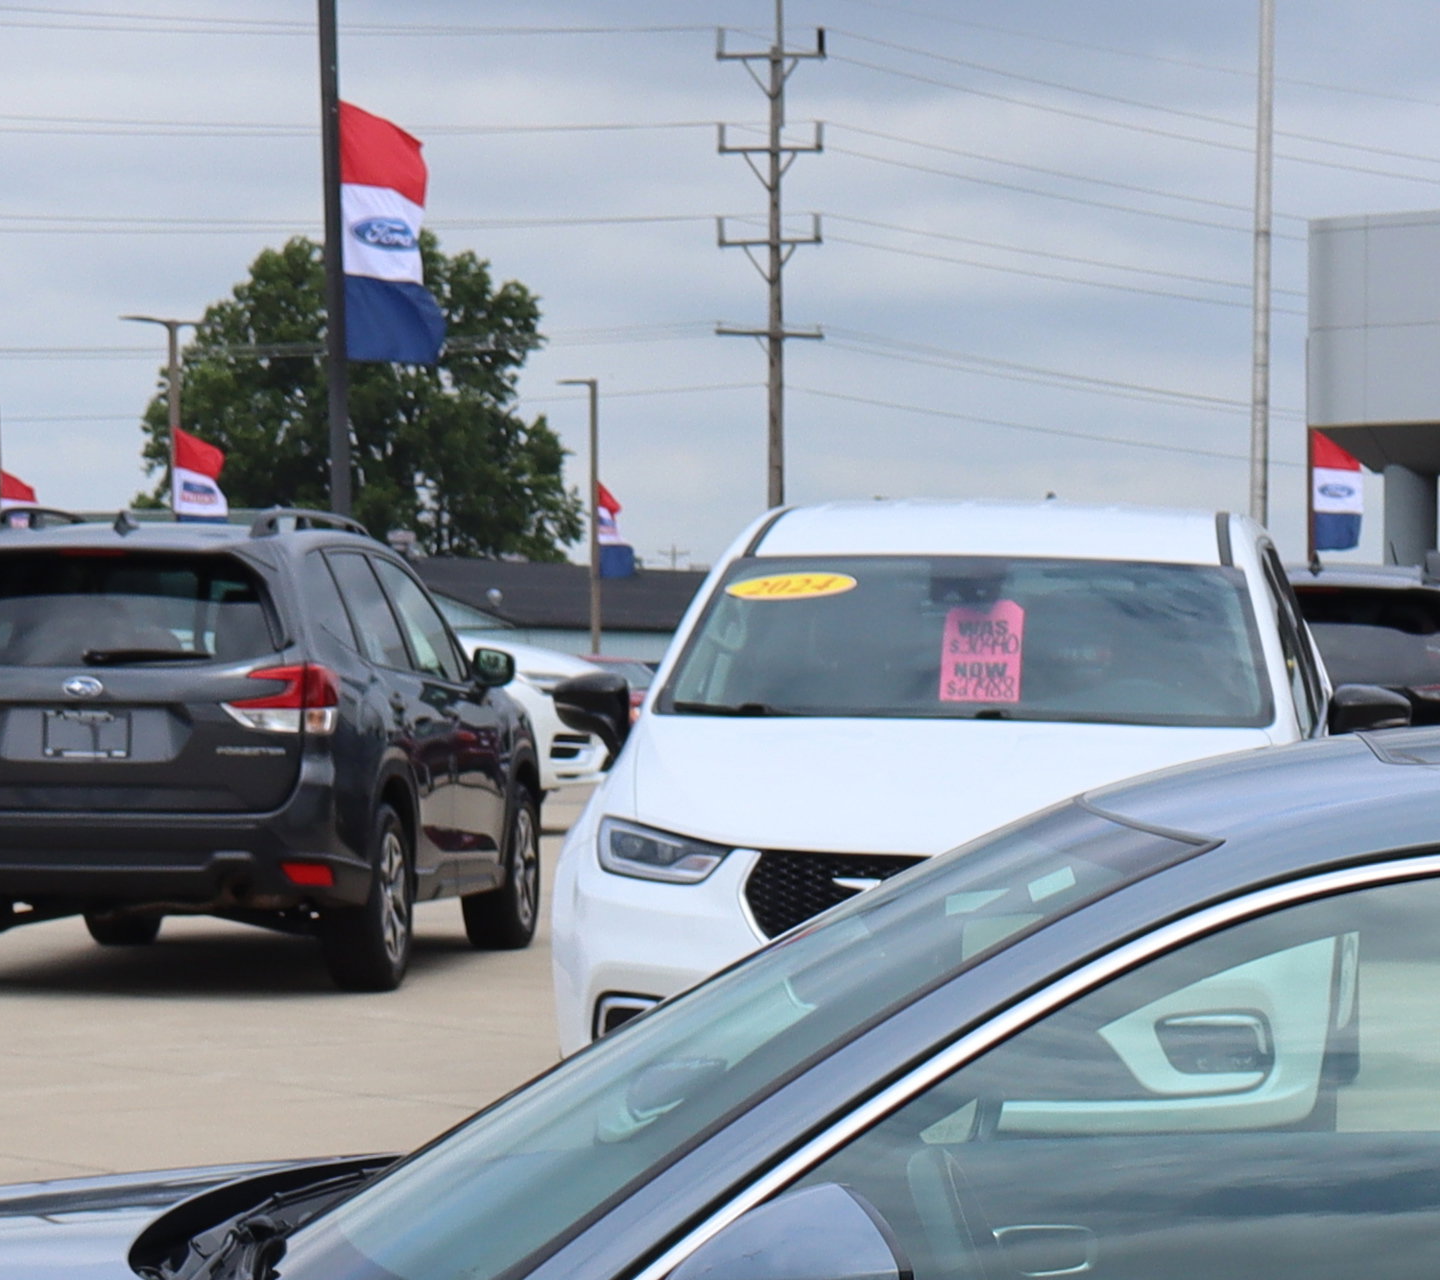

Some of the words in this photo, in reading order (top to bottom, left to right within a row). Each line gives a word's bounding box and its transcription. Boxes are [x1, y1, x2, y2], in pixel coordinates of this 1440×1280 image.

[365, 221, 413, 248] Ford
[743, 576, 839, 595] 2024
[957, 620, 1009, 637] WAS
[953, 661, 1009, 678] NOW
